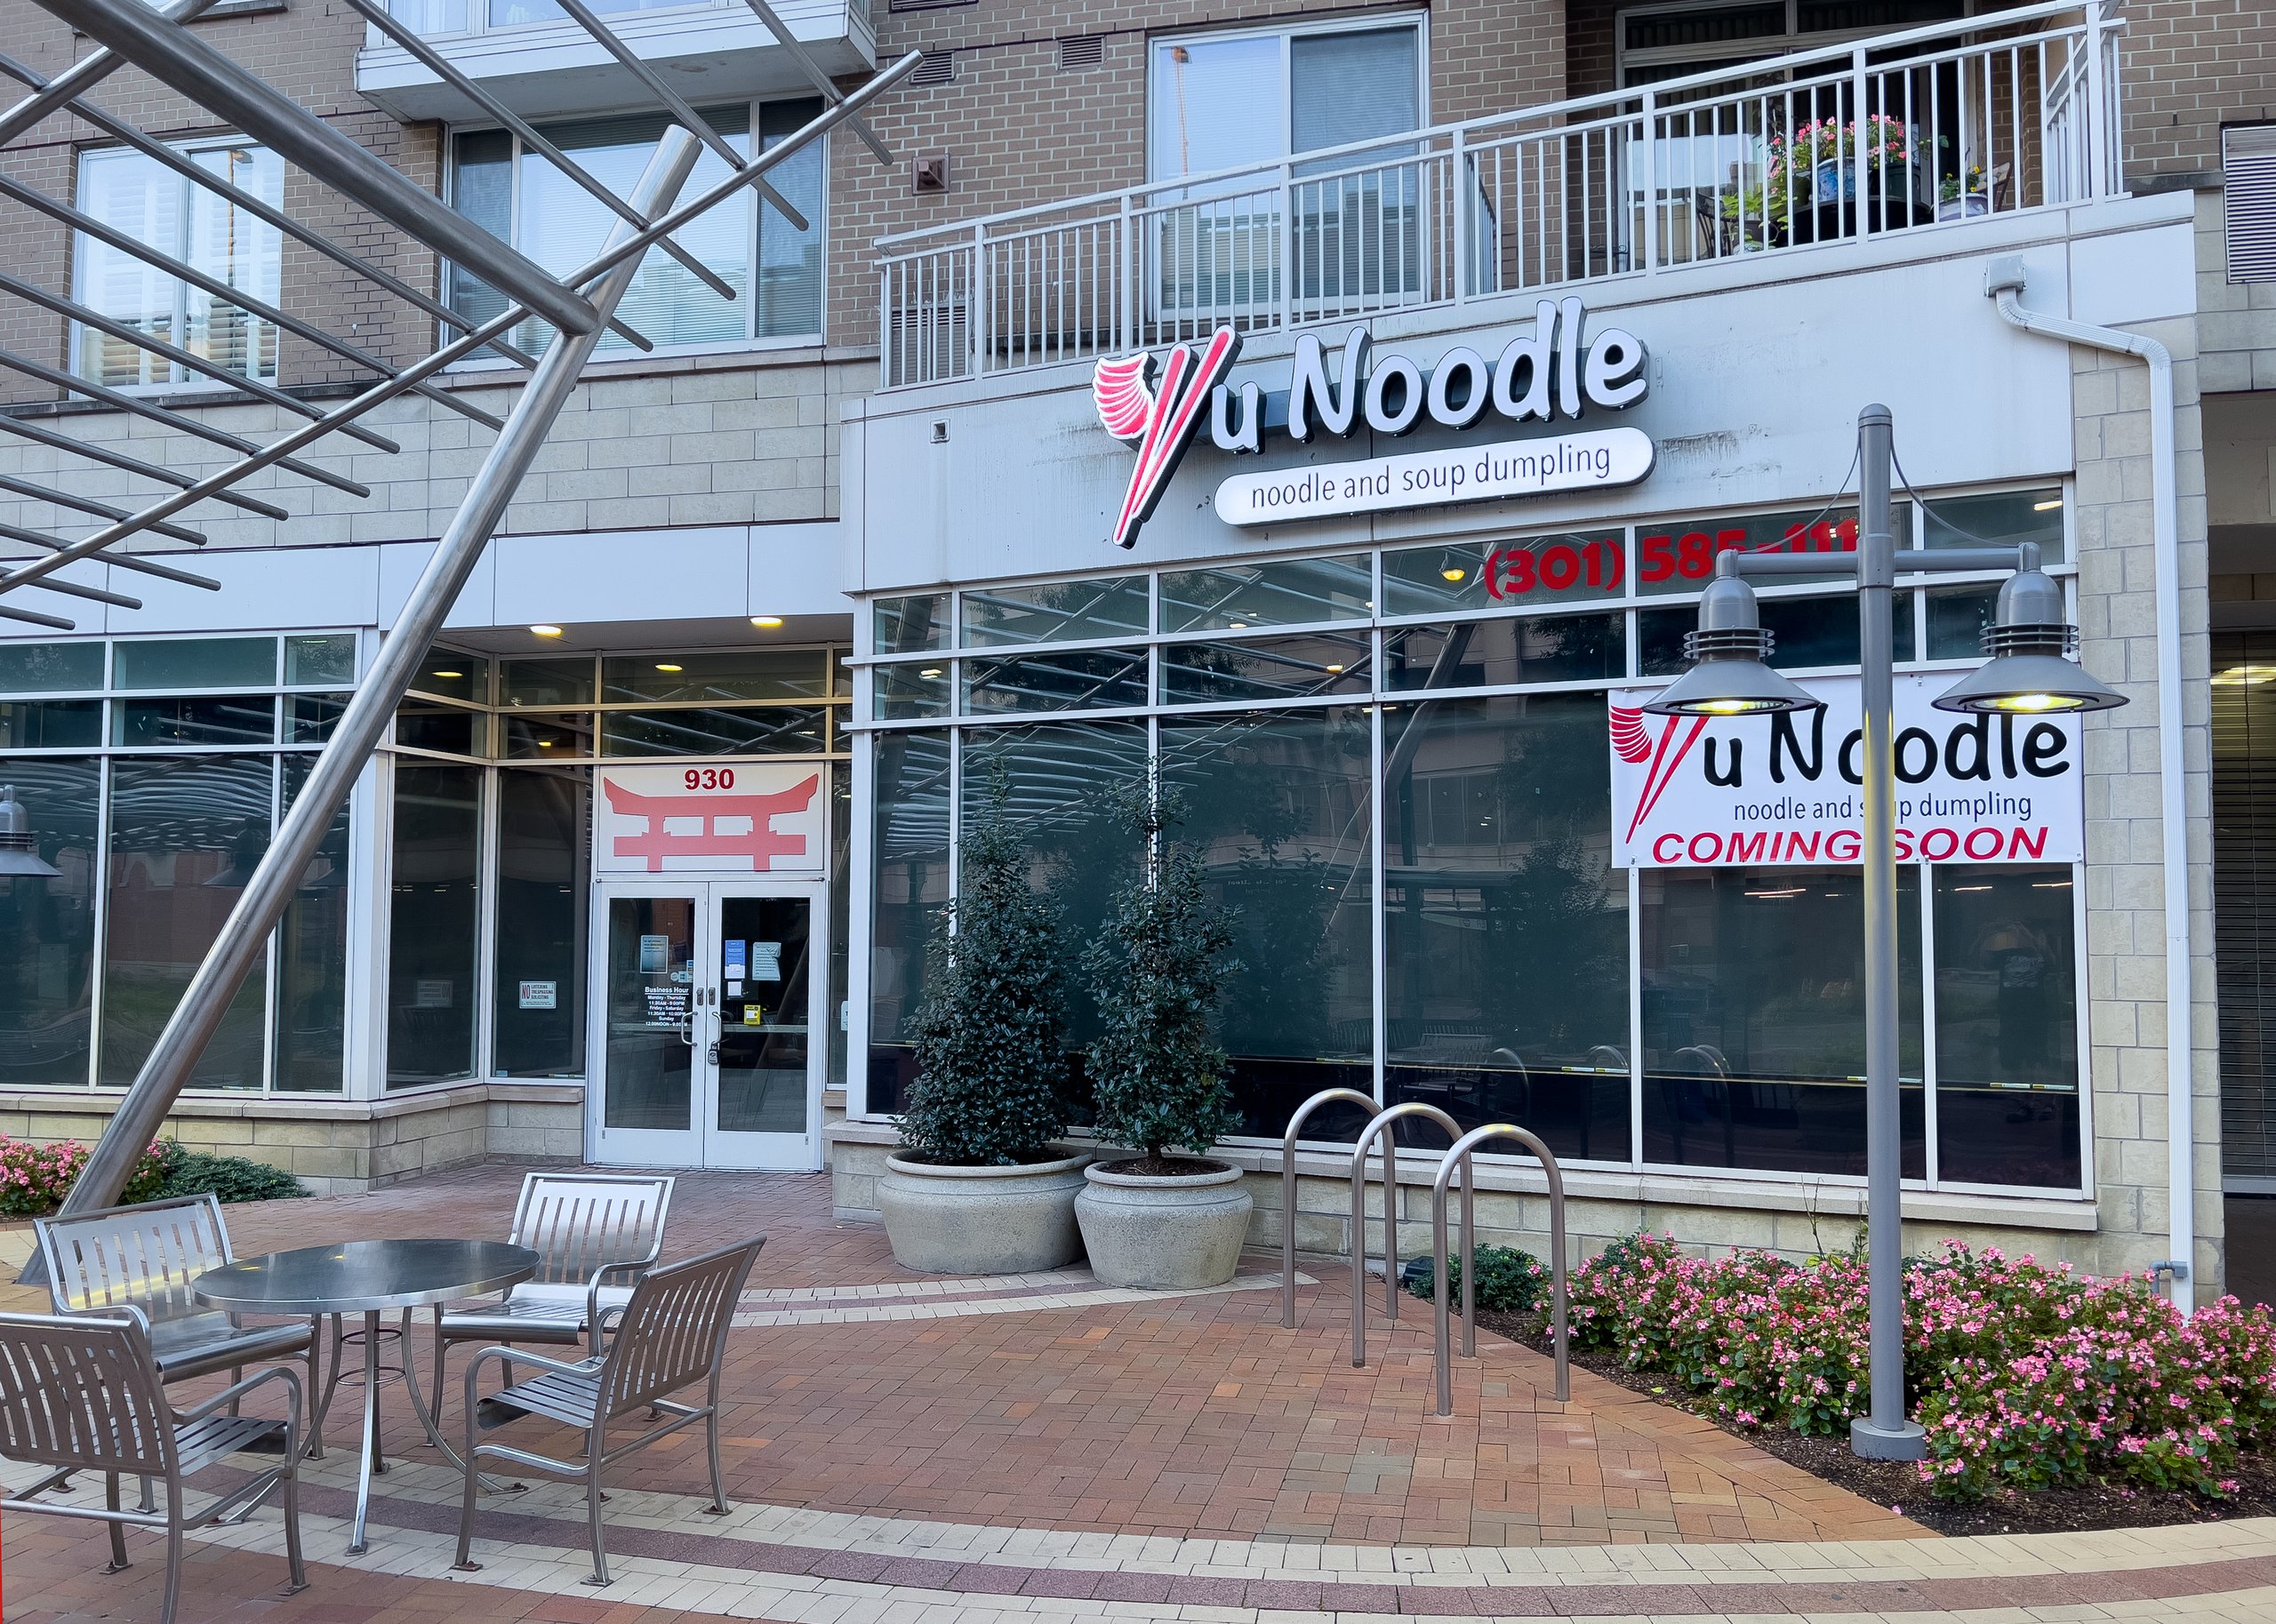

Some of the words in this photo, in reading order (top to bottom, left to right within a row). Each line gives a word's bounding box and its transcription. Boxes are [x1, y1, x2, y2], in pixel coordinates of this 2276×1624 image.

[1288, 297, 1647, 442] Noodle
[1252, 473, 1335, 508] noodle
[1344, 465, 1390, 498] and
[1403, 465, 1465, 495] soup
[1475, 443, 1610, 485] dumpling
[1484, 539, 1624, 601] (301)
[685, 768, 734, 790] 930
[1735, 796, 1806, 820] noodle
[1813, 795, 1851, 819] and
[1919, 791, 2032, 822] dumpling
[1652, 830, 1862, 863] COMING
[1895, 827, 2048, 860] SOON
[521, 984, 531, 999] NO
